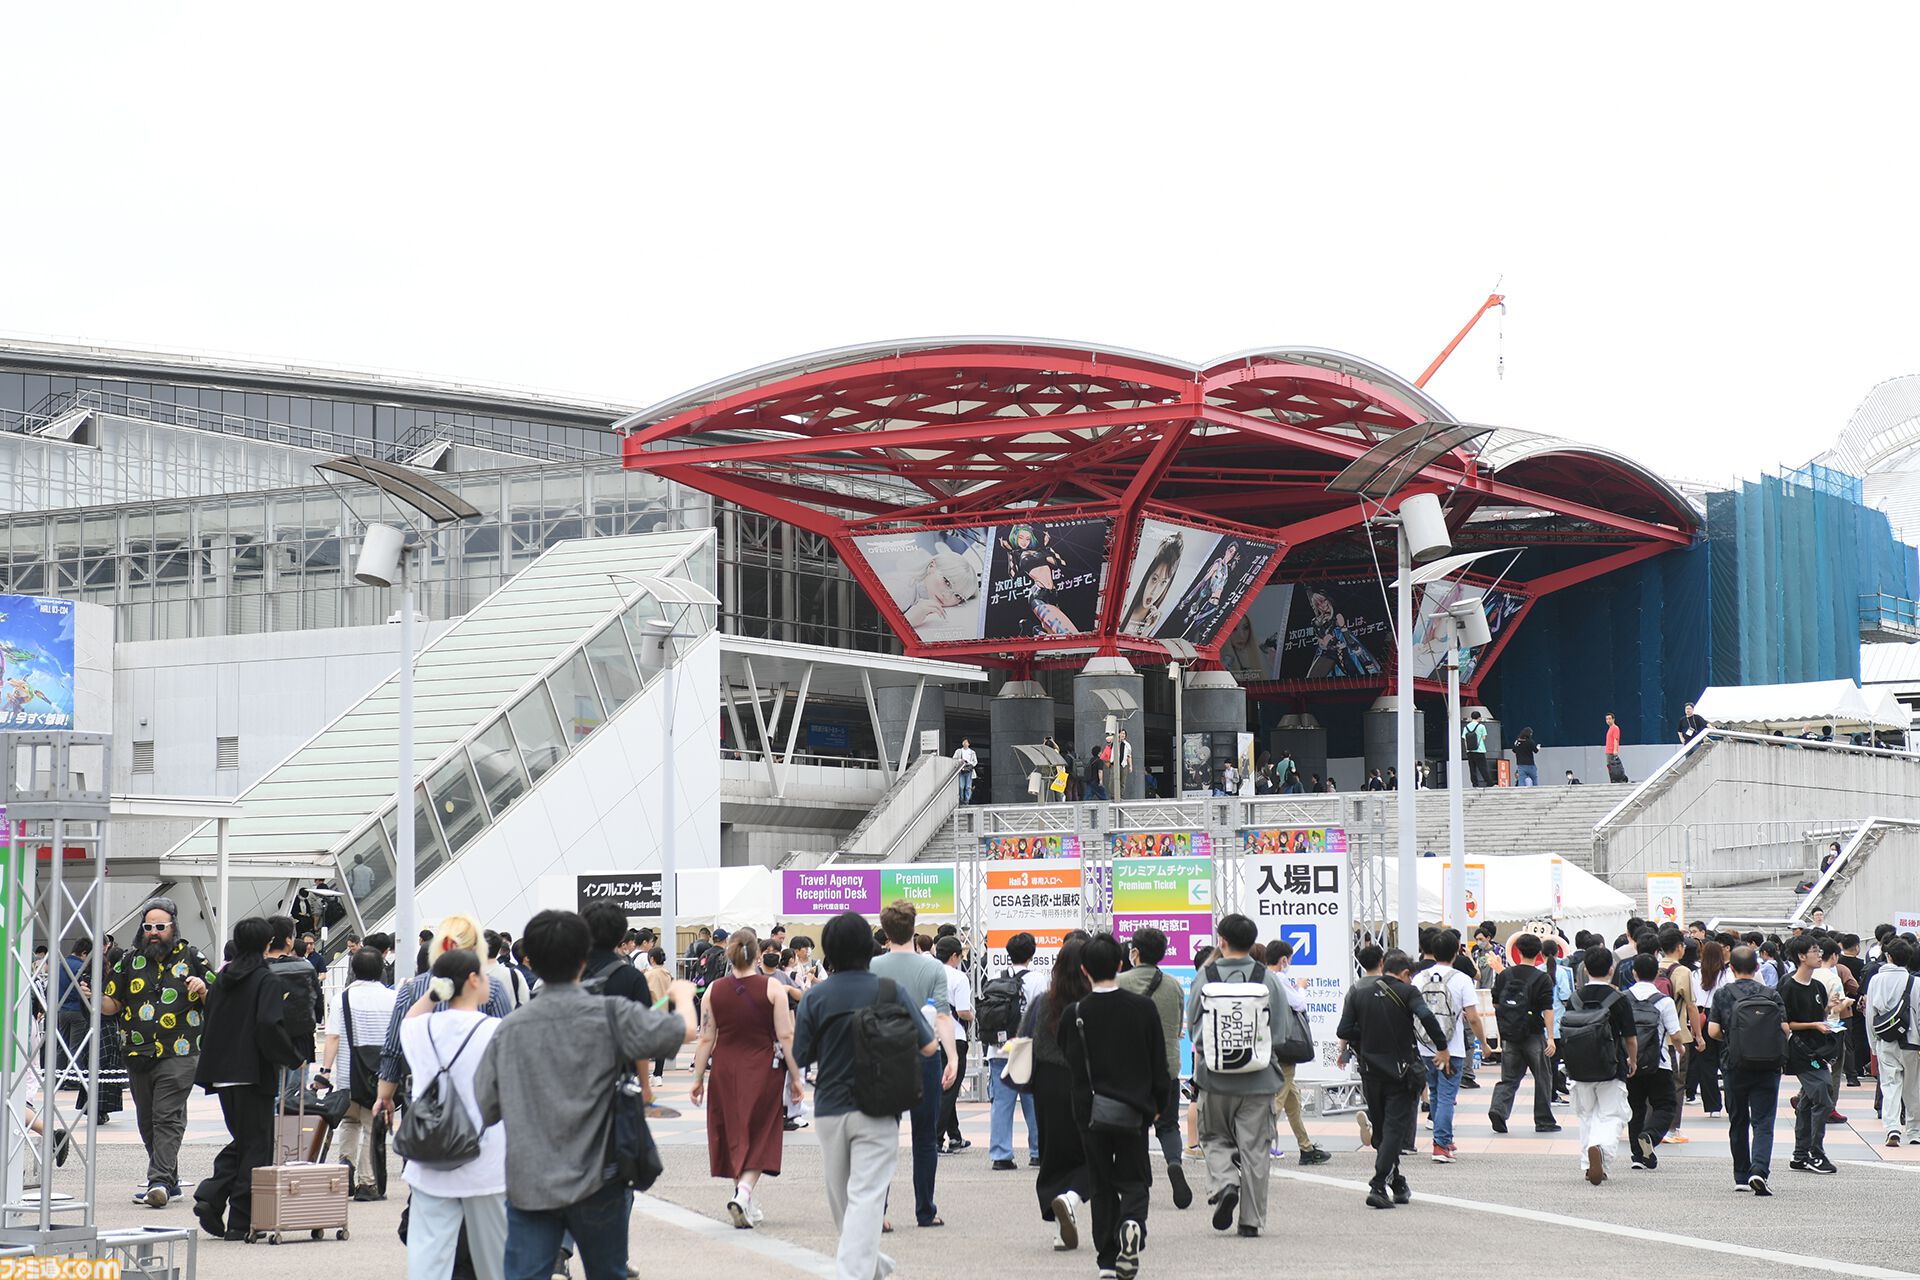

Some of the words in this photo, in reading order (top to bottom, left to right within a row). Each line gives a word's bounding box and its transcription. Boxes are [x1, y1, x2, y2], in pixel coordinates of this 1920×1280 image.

[1118, 864, 1204, 877] プレミアムチケット
[799, 873, 827, 886] Travel
[829, 873, 864, 887] Agency
[895, 873, 939, 885] Premium
[1118, 880, 1152, 890] Premium
[1154, 880, 1177, 890] Ticket
[1256, 864, 1339, 895] 入場口
[583, 880, 662, 897] インフルエンサー受
[796, 888, 842, 901] Reception
[844, 887, 868, 899] Desk
[903, 886, 932, 899] Ticket
[624, 900, 662, 911] Registration
[992, 893, 1080, 907] CESA会員校・出展校
[1259, 899, 1339, 916] Entrance
[992, 954, 1012, 966] GUE
[1316, 977, 1340, 987] Ticket
[1306, 989, 1344, 998] ストチケット
[1306, 1003, 1337, 1013] TRANCE
[1231, 1001, 1243, 1048] NORTH
[1220, 1015, 1232, 1048] FACE
[1243, 1021, 1254, 1047] THE
